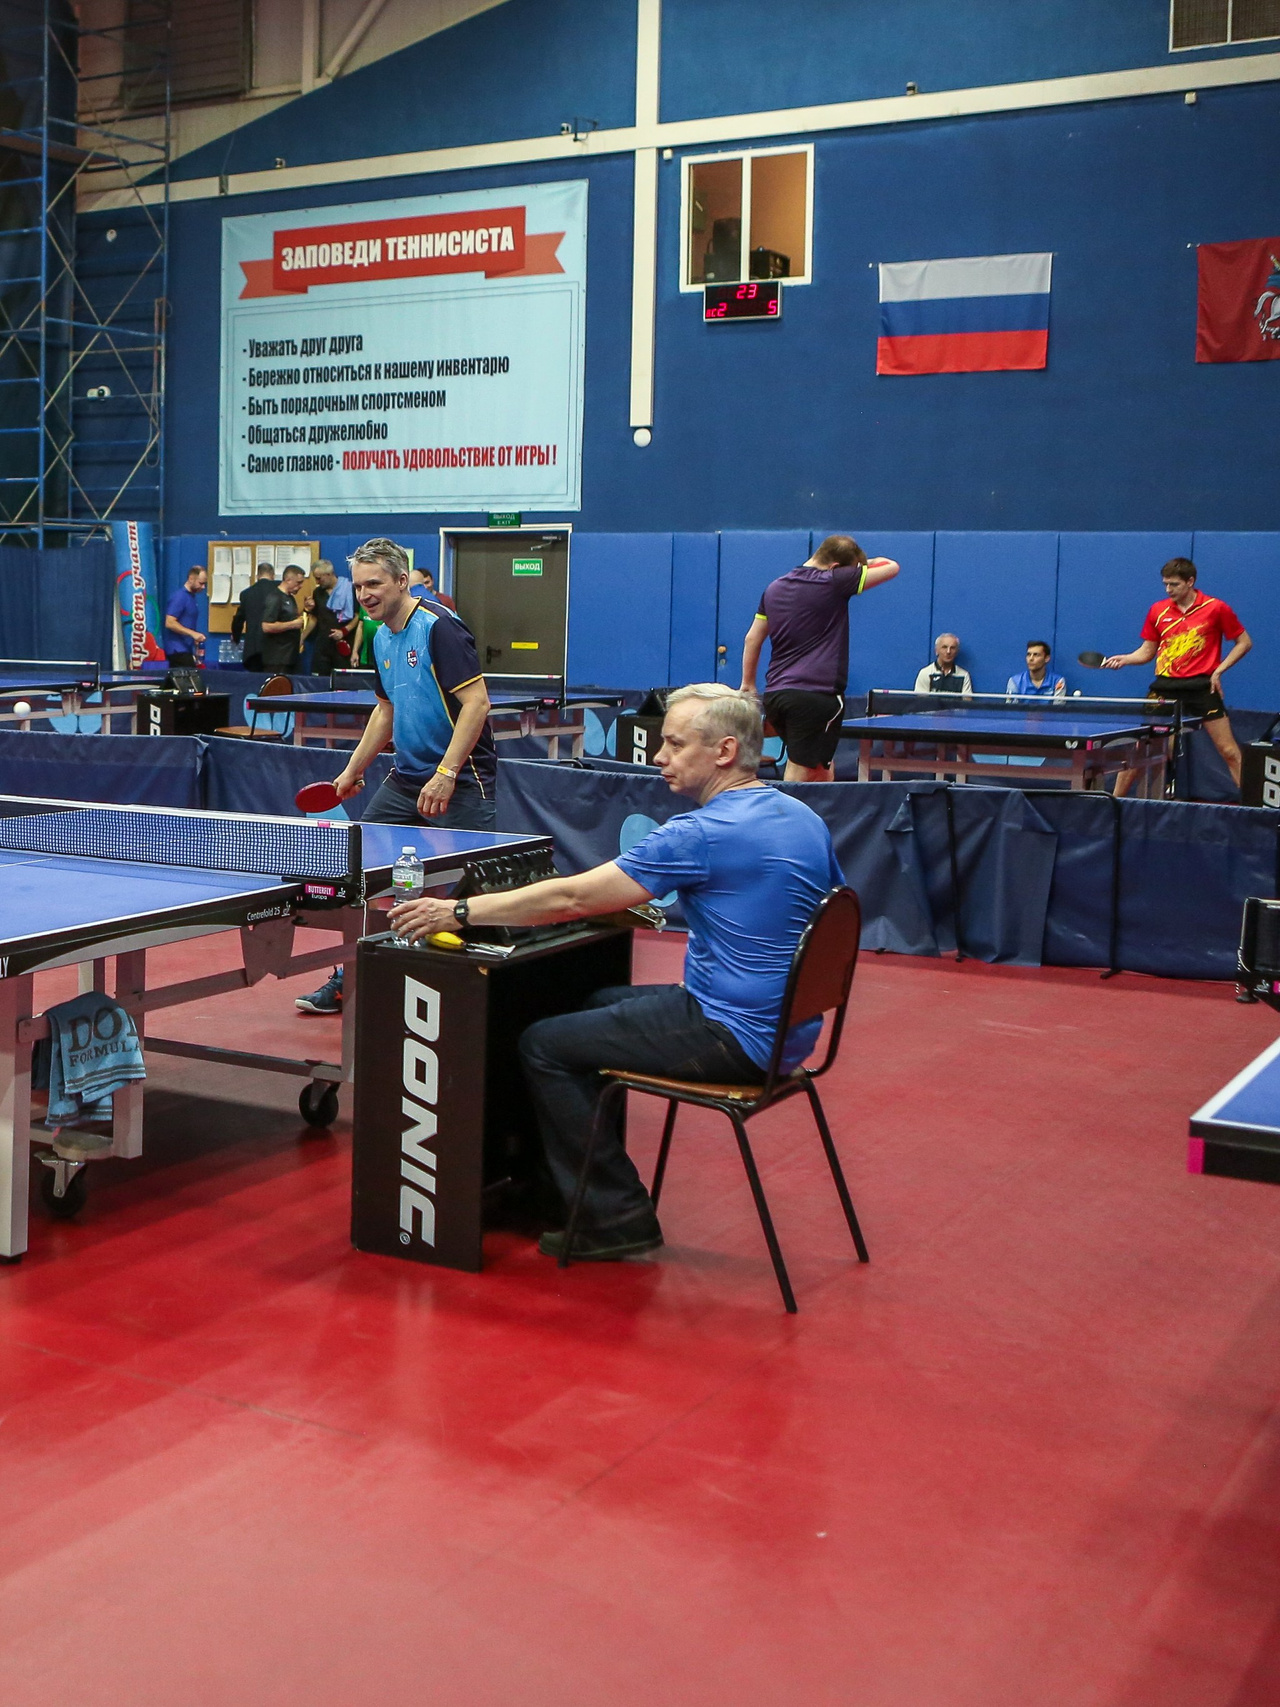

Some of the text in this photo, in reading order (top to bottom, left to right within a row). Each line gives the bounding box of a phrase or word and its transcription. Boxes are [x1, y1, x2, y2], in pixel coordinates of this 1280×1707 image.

[281, 226, 516, 271] ЗАПОВЕДИ ТЕННИСИСТА
[736, 284, 758, 299] 23
[249, 339, 298, 358] Уважать
[300, 337, 327, 357] друг
[329, 334, 363, 356] друга
[249, 367, 300, 388] Бережно
[303, 363, 372, 384] относиться
[374, 362, 382, 380] к
[384, 360, 434, 379] нашему
[437, 356, 510, 376] инвентарю
[248, 396, 278, 415] Быть
[281, 394, 359, 415] порядочным
[361, 390, 446, 412] спортсменом
[248, 425, 306, 446] Общаться
[308, 420, 388, 445] дружелюбно
[248, 453, 284, 473] Самое
[286, 454, 333, 472] главное
[343, 450, 400, 470] ПОЛУЧАТЬ
[403, 446, 495, 472] УДОВОЛЬСТВИЕ
[498, 446, 513, 467] ОТ
[514, 563, 541, 571] ВЫХОД
[247, 907, 281, 921] Centrefold 25
[399, 974, 441, 1248] DONIC
